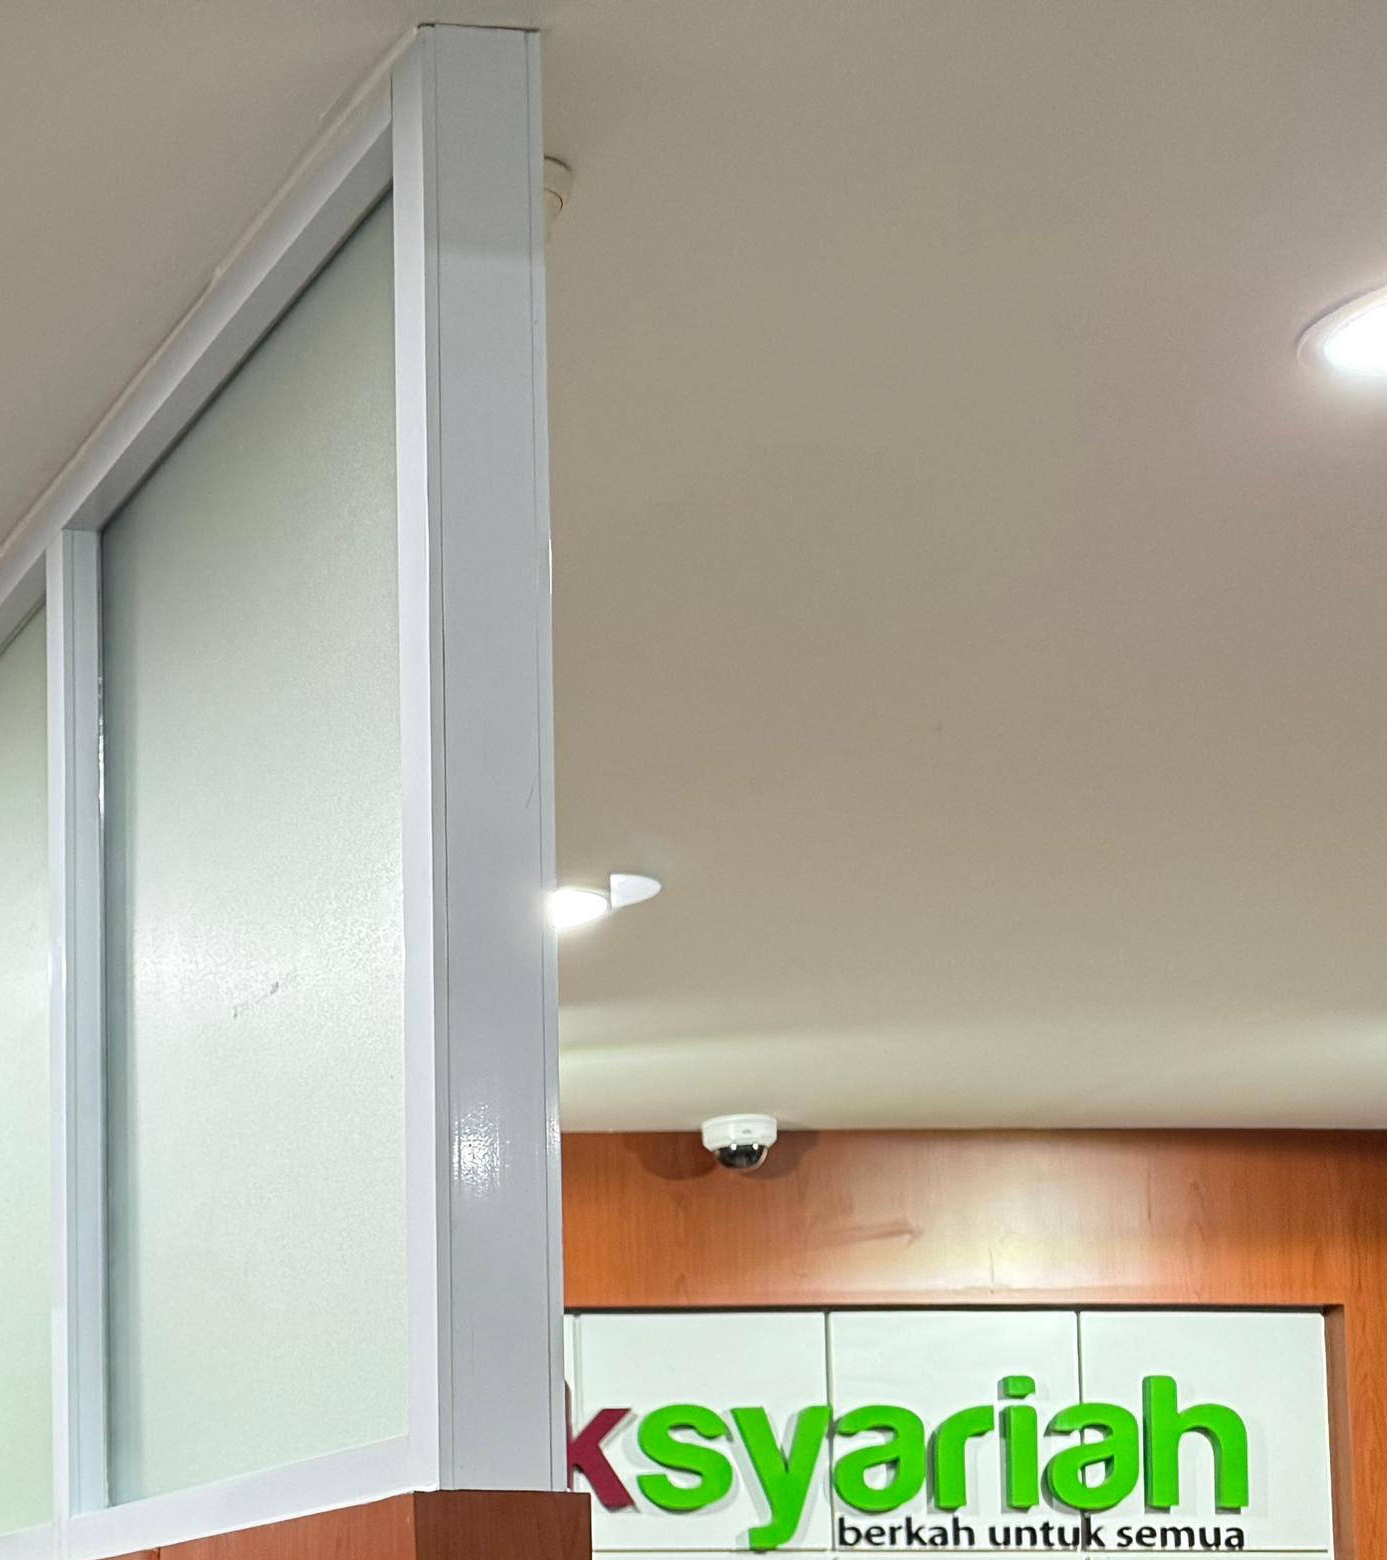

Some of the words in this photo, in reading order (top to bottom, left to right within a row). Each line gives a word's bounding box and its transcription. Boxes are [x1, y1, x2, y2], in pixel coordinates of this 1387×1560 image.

[838, 1516, 975, 1547] berkah
[988, 1518, 1106, 1549] untuk
[1116, 1523, 1245, 1550] semua
